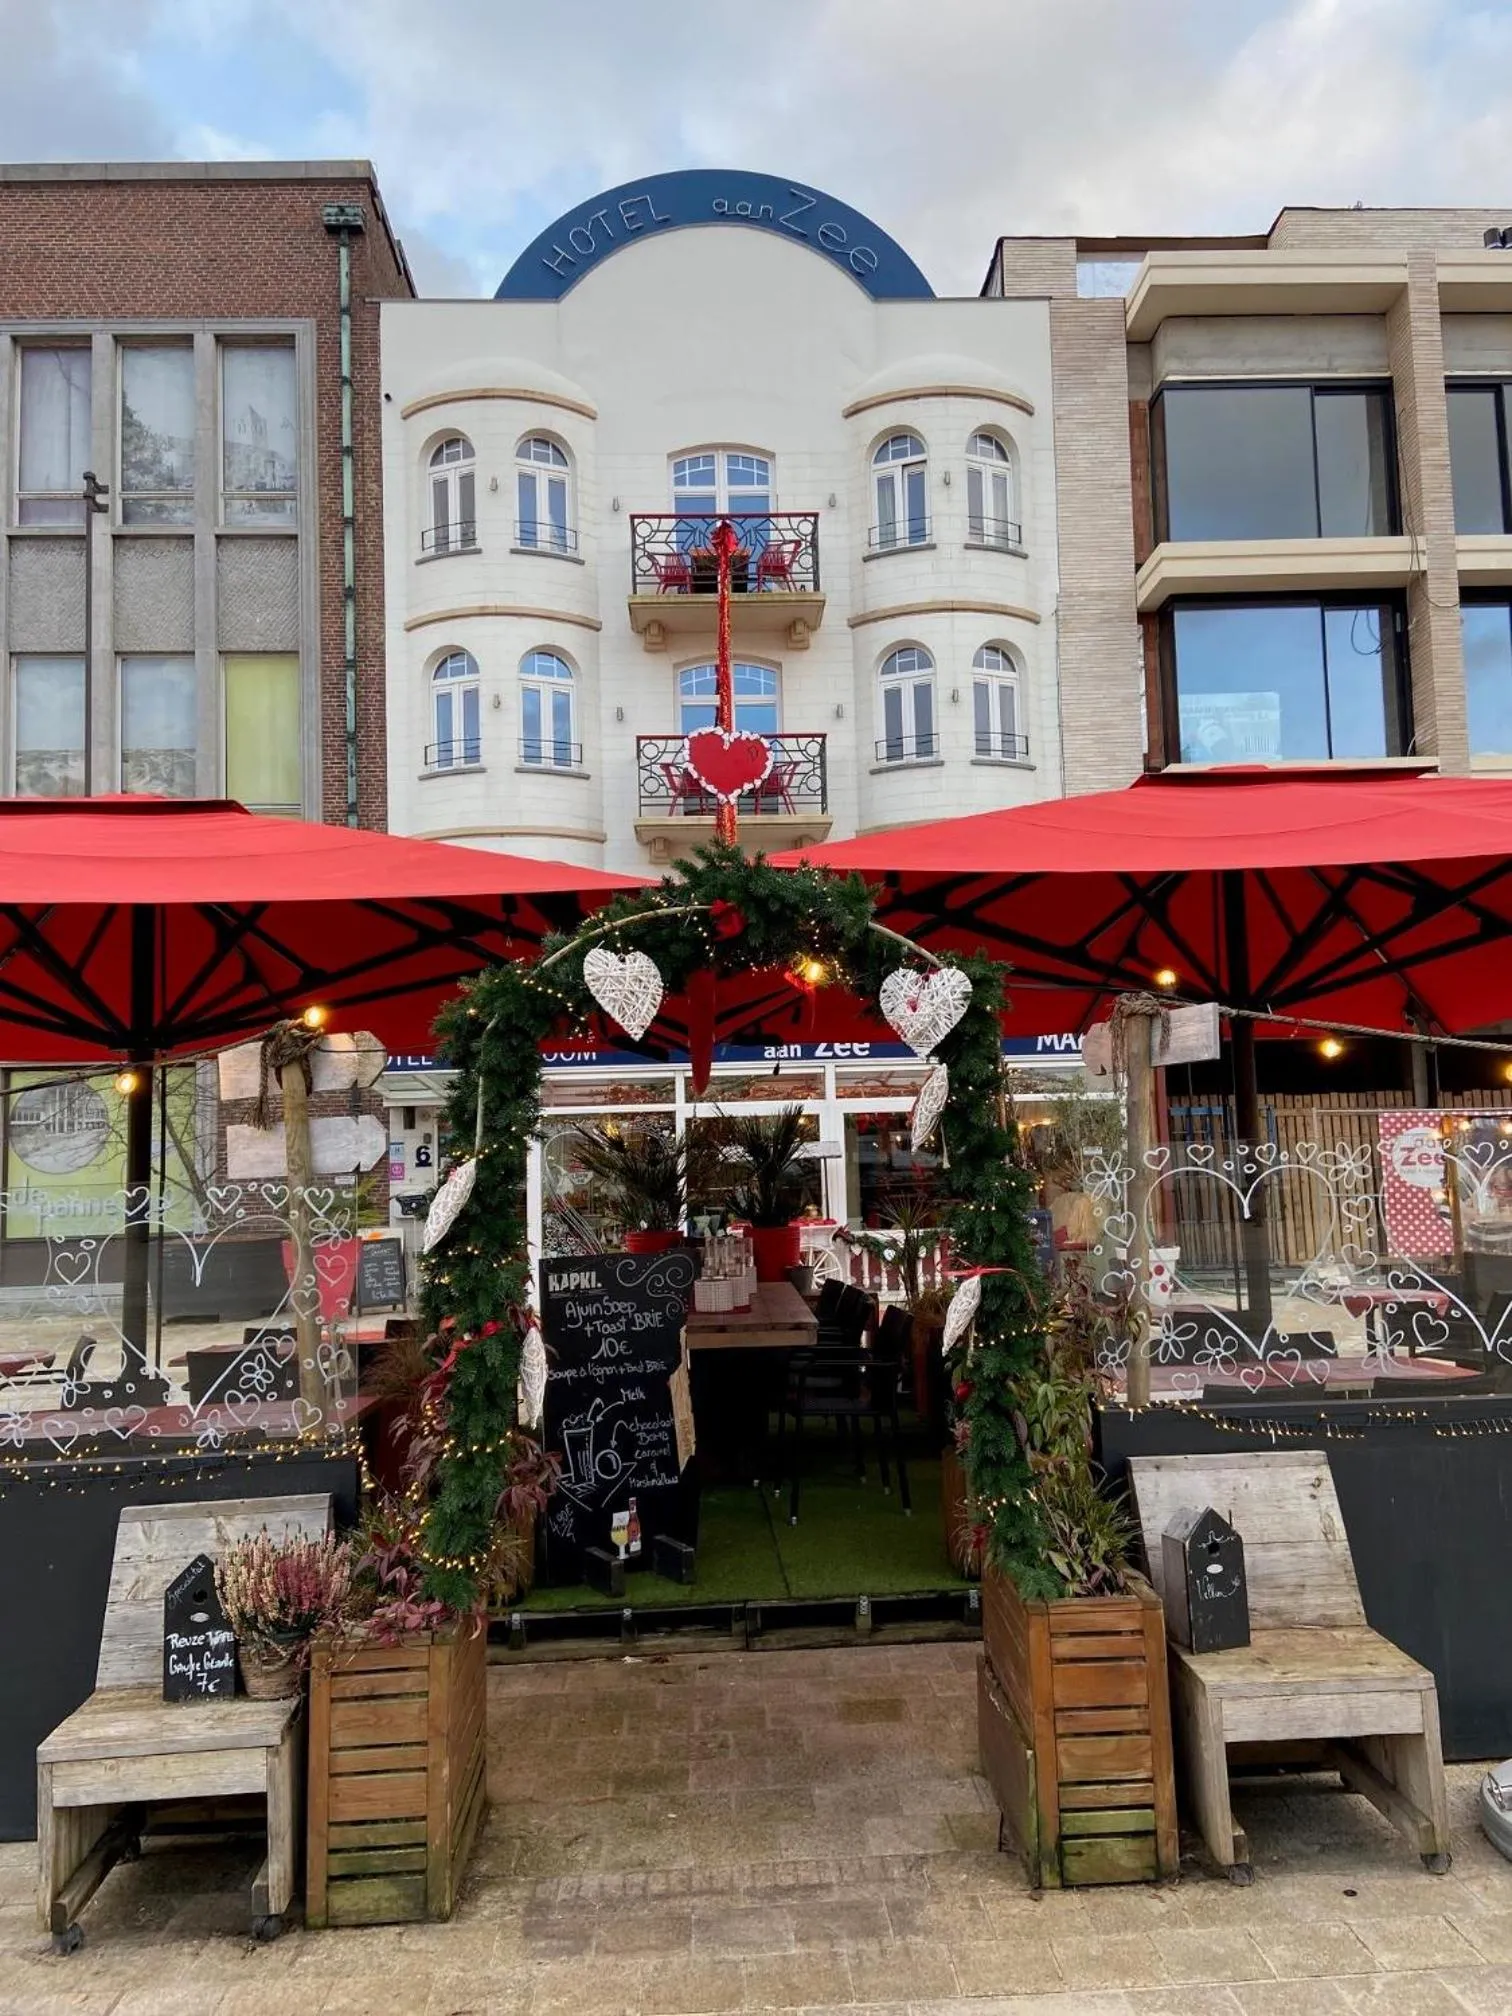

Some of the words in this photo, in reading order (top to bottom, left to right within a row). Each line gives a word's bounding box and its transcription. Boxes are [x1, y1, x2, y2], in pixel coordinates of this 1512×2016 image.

[542, 195, 670, 278] HOTEL
[712, 198, 773, 220] aan
[778, 188, 878, 276] Zee
[763, 1043, 802, 1058] aan
